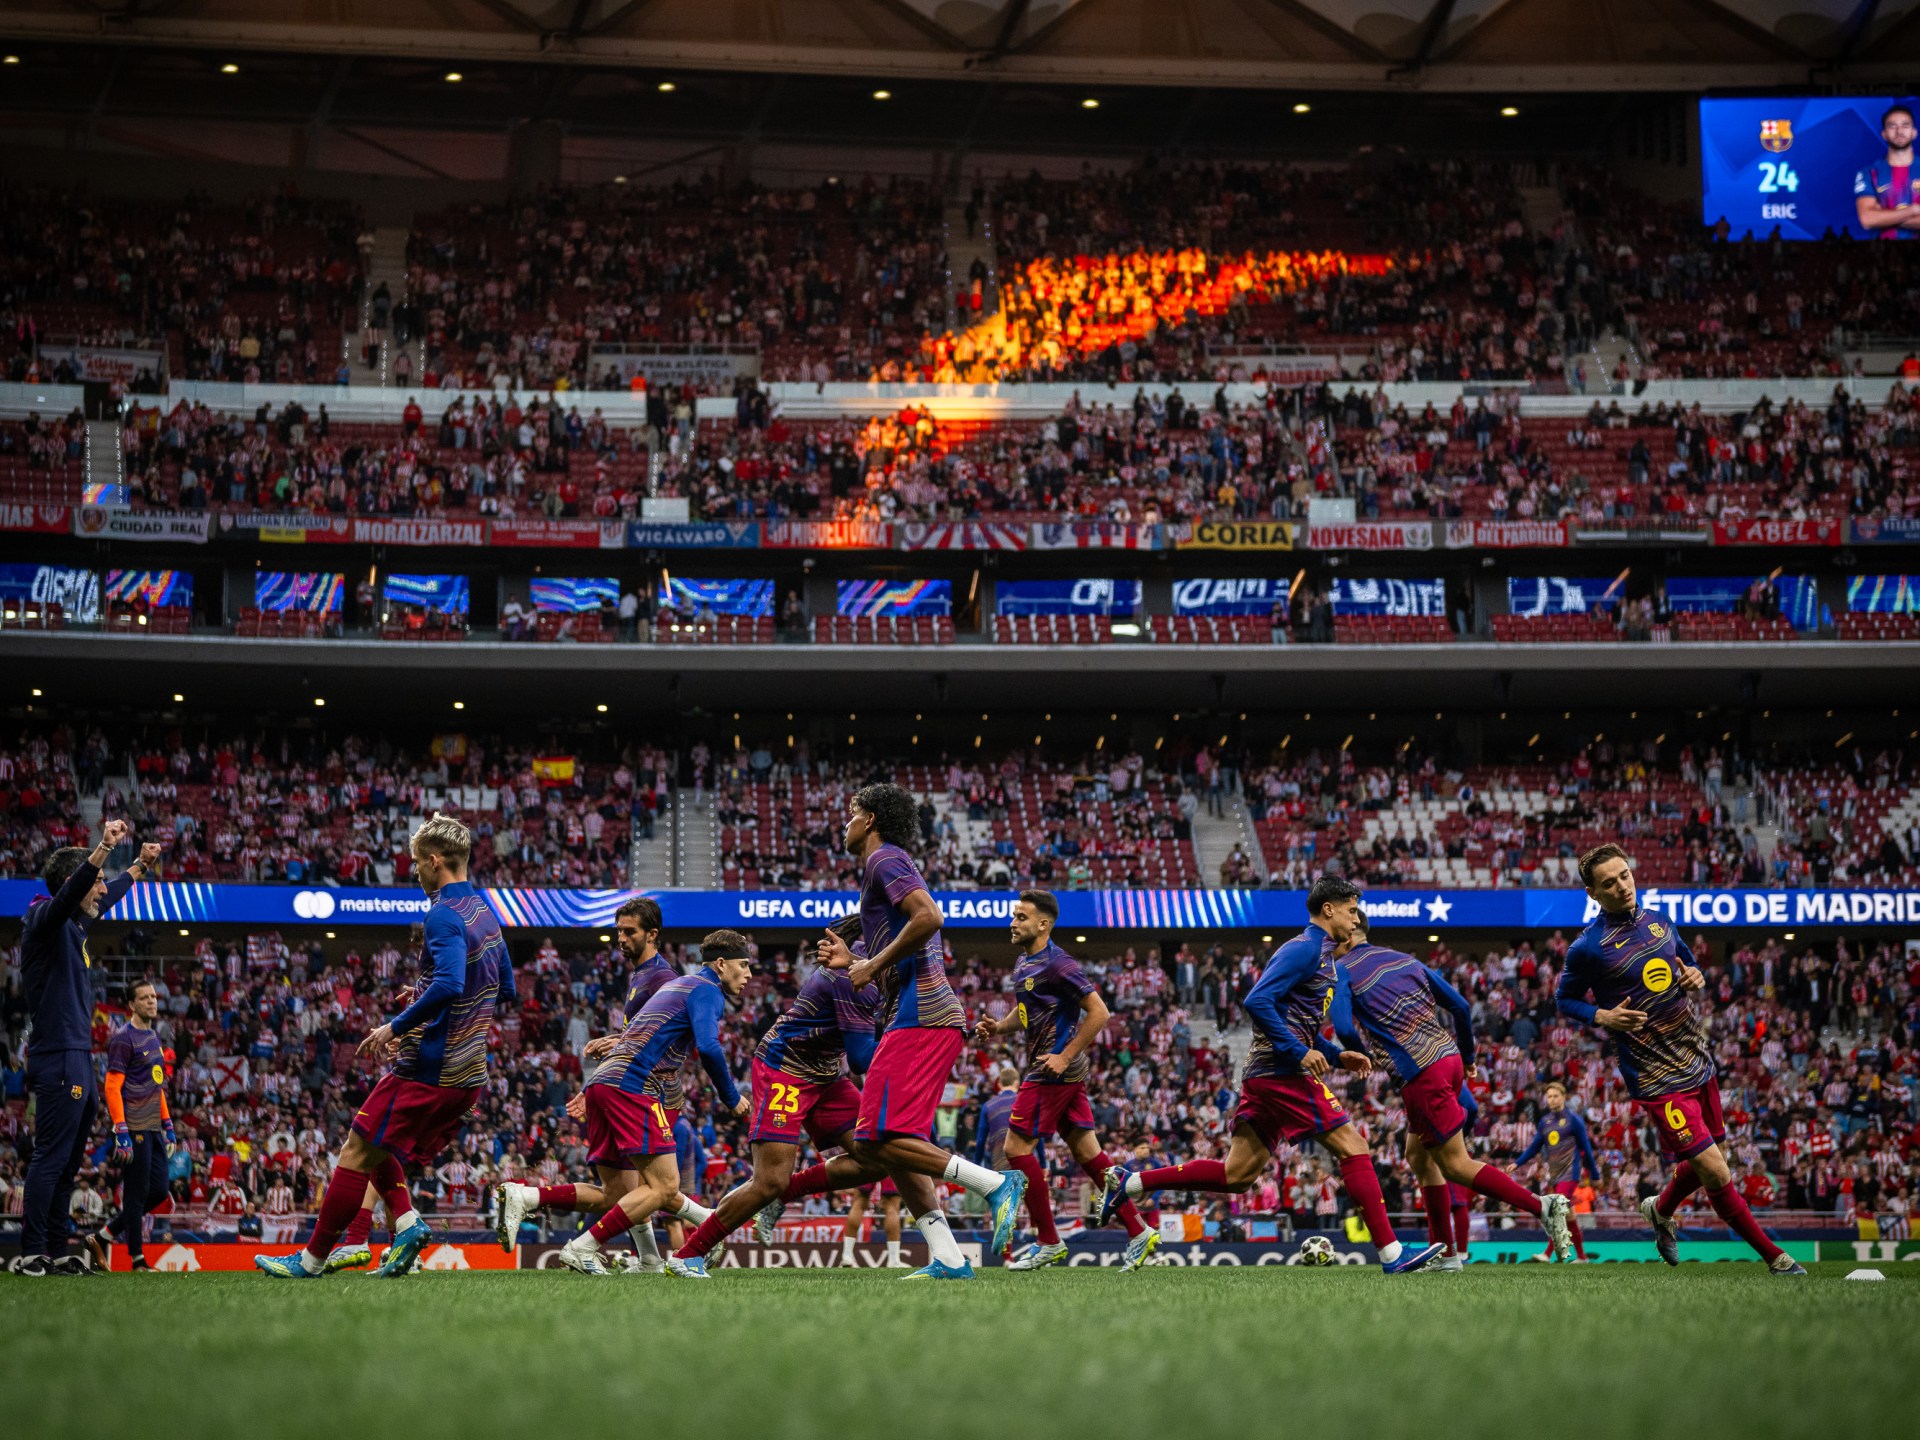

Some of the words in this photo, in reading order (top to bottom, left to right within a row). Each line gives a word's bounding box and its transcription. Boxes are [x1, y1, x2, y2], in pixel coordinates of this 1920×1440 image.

[1758, 162, 1799, 192] 24
[1762, 204, 1797, 219] ERIC
[110, 519, 162, 534] CIUDAD
[170, 521, 202, 535] REAL
[354, 521, 484, 546] MORALZARZAL
[634, 523, 725, 545] VICÁLVARO
[1196, 522, 1290, 545] CORIA
[1310, 527, 1405, 547] NOVESANA
[1746, 521, 1809, 543] ABEL
[340, 897, 432, 912] mastercard
[739, 899, 796, 918] UEFA
[799, 899, 861, 919] CHAM
[1358, 900, 1421, 918] ineken
[1582, 888, 1737, 924] AÉTICO
[1744, 893, 1789, 923] DE
[1796, 893, 1920, 923] MADRID
[768, 1082, 800, 1113] 23
[1664, 1100, 1687, 1130] 6
